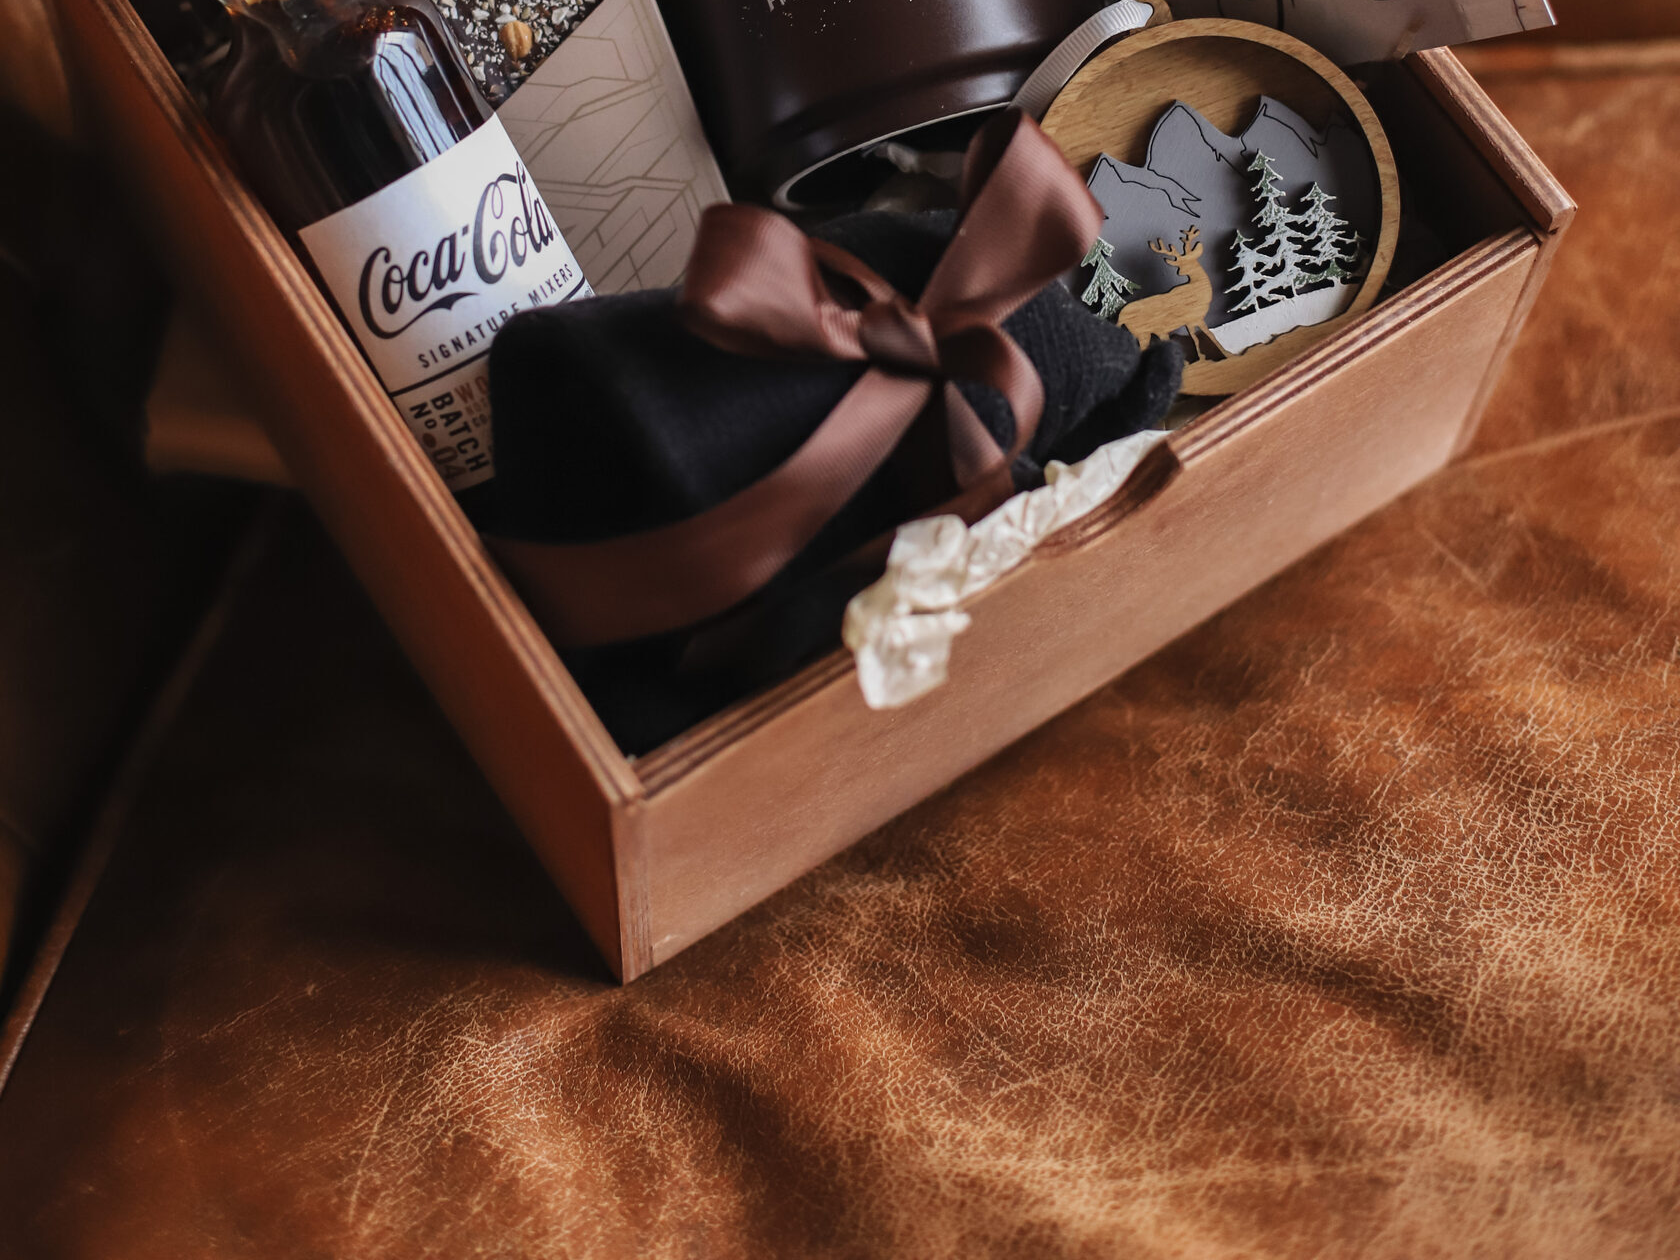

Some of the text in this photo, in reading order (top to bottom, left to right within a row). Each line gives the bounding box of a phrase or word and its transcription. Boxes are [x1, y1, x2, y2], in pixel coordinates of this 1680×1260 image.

[358, 161, 555, 340] Coca-Cola
[528, 263, 573, 307] MIXERS
[430, 391, 490, 472] BATCH
